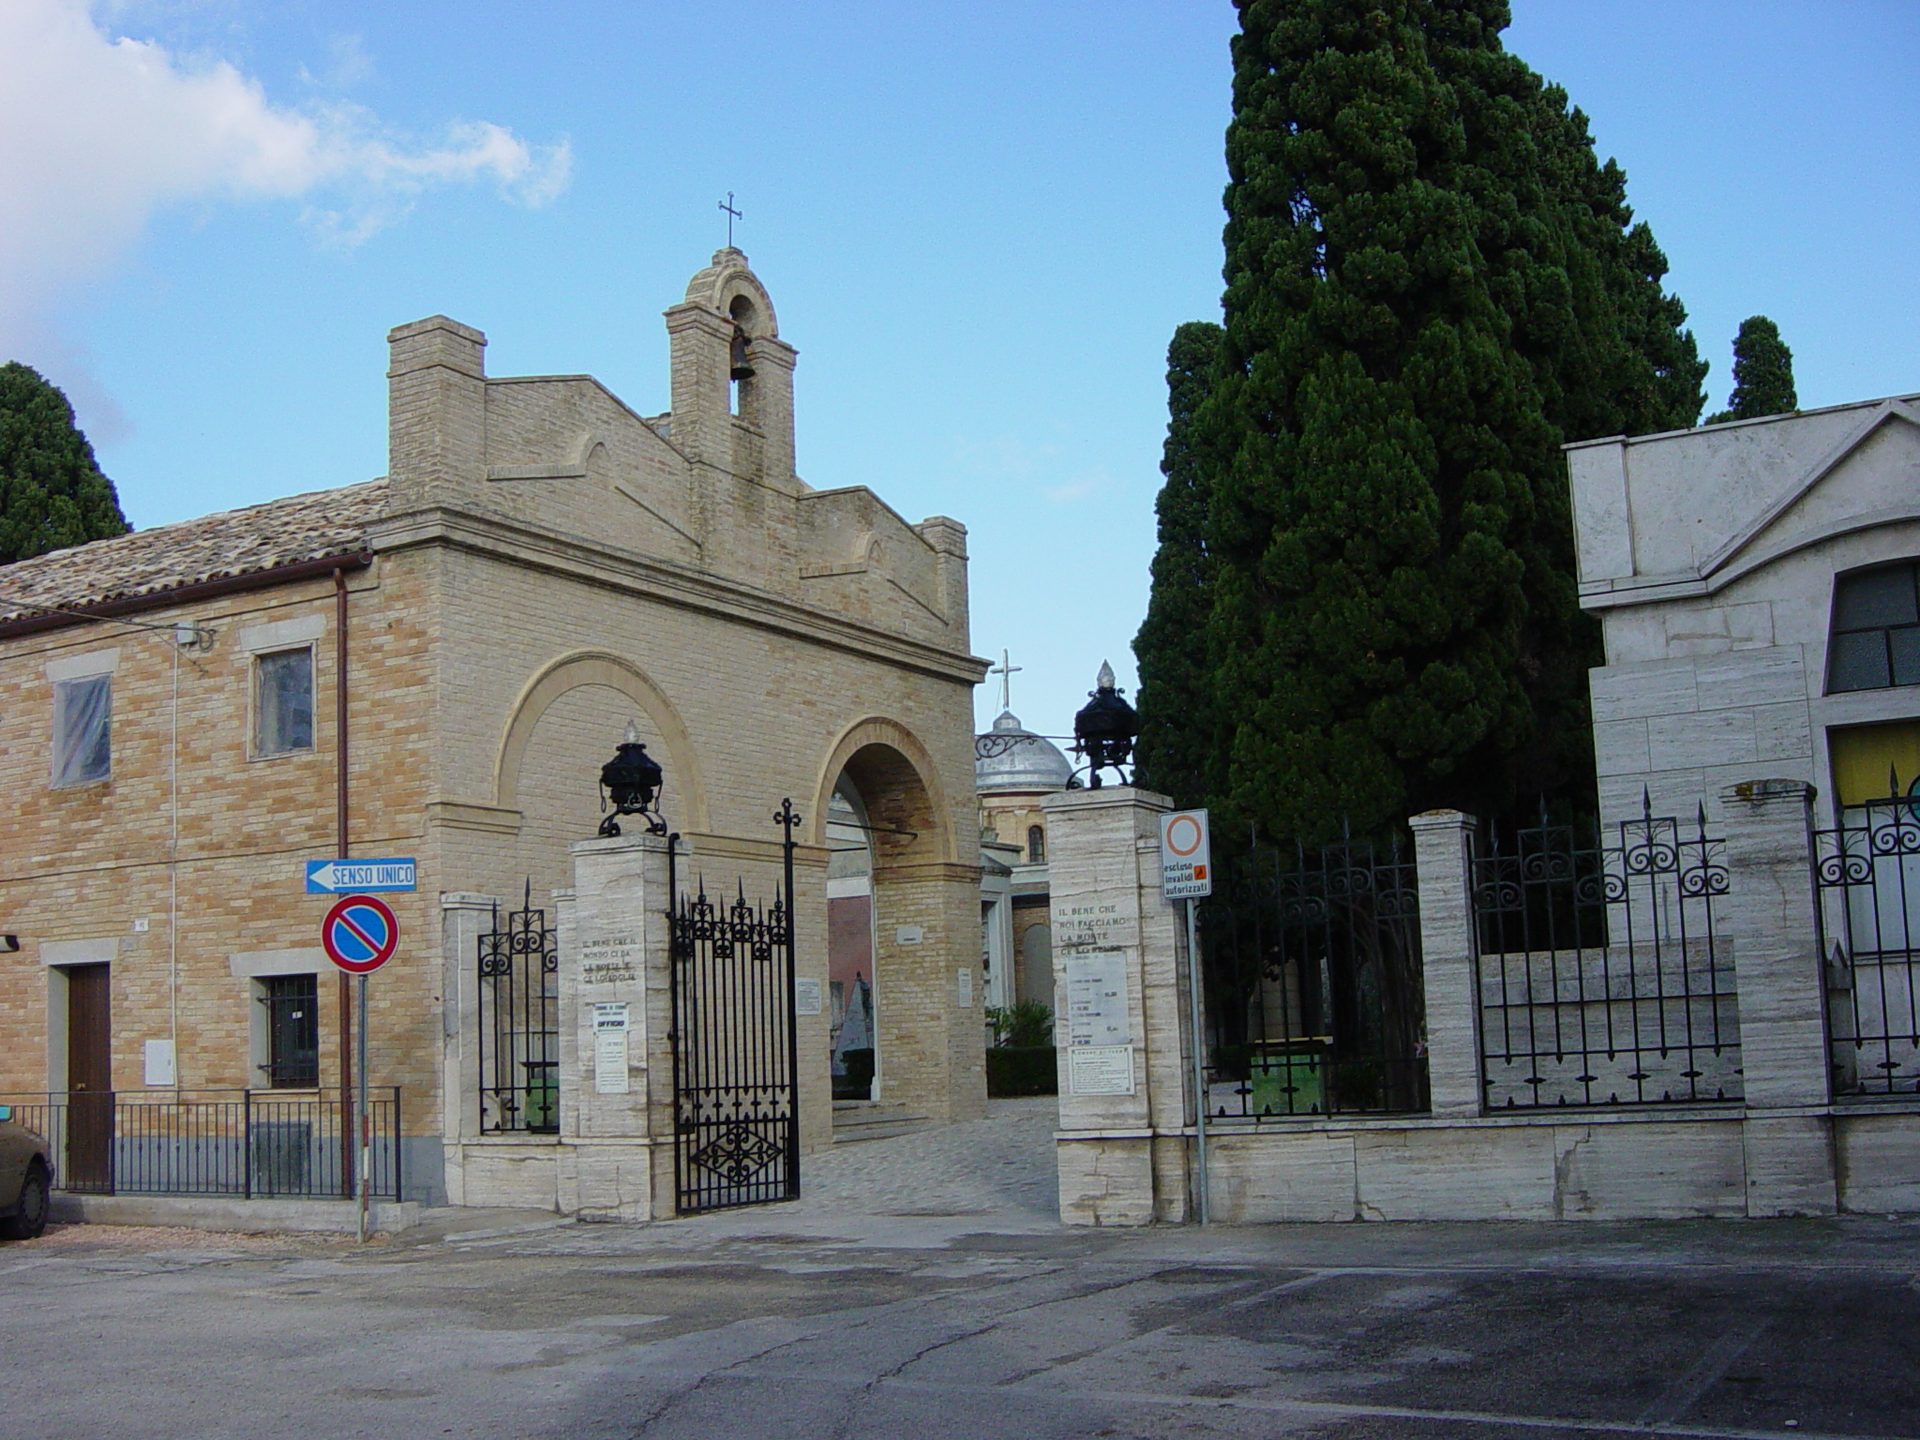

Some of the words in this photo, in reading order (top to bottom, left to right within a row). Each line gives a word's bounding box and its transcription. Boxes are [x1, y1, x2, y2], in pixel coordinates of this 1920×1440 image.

[1164, 862, 1193, 872] escluso
[333, 867, 372, 885] SENSO
[377, 866, 413, 883] UNICO
[1165, 882, 1207, 895] autorizzati
[1058, 908, 1068, 917] IL
[1071, 907, 1094, 916] BENE
[1098, 904, 1116, 914] CHE
[1060, 920, 1075, 929] NOI
[1078, 917, 1127, 929] FACCIAMO
[1060, 934, 1073, 943] LA
